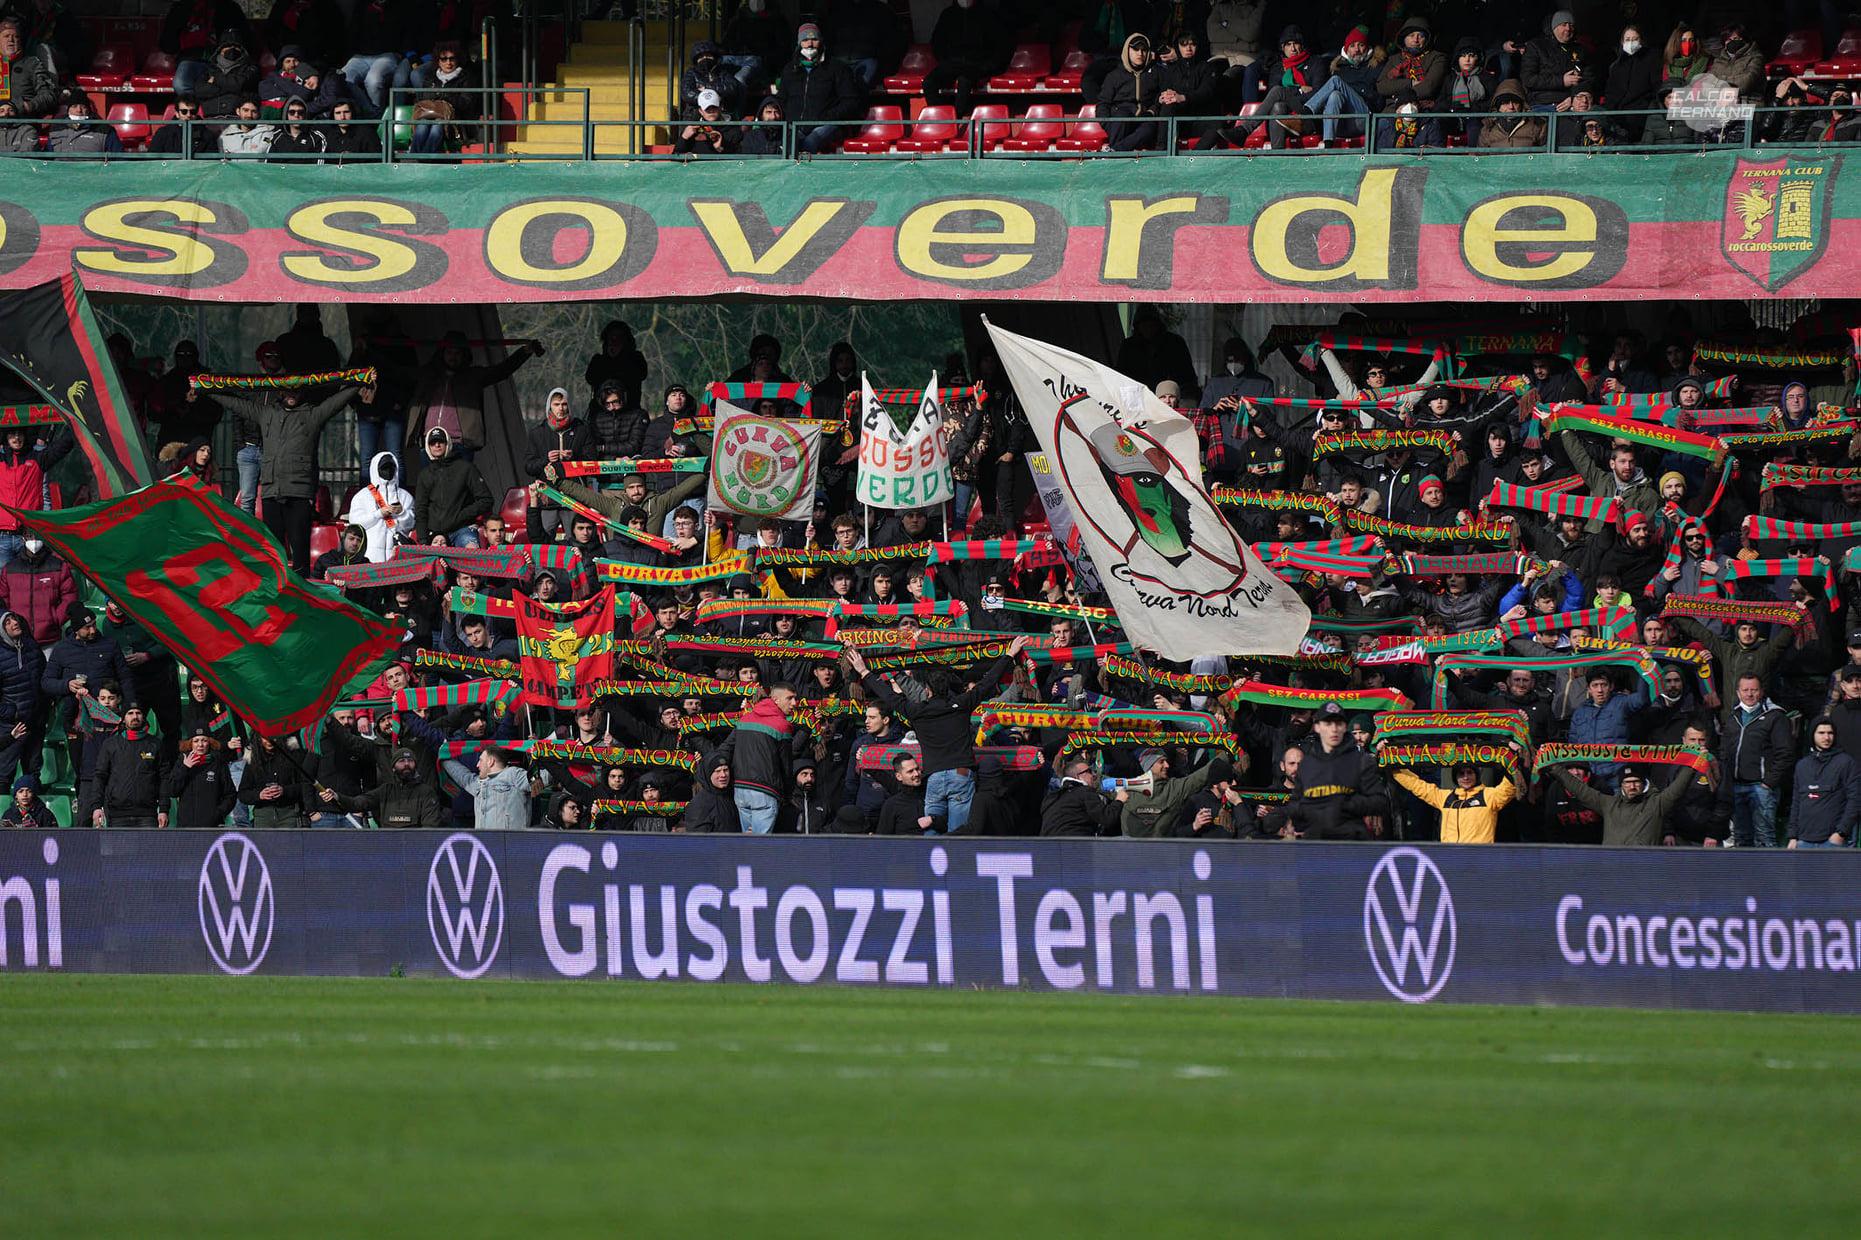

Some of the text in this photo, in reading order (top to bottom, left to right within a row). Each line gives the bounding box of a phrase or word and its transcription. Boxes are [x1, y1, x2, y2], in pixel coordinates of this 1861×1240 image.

[1742, 167, 1824, 178] TERNANA CLUB
[1728, 240, 1814, 252] roccarossoverde
[1620, 422, 1677, 445] CARASSI
[724, 426, 798, 472] CURVA
[724, 470, 790, 509] NORD
[1212, 485, 1264, 508] URVA
[1345, 508, 1508, 543] CURVA NORD
[758, 546, 836, 566] CURVA
[1178, 592, 1239, 618] Nord
[1298, 691, 1361, 701] CARASSI
[997, 711, 1090, 729] CURVA
[1383, 714, 1425, 733] Curva
[1432, 712, 1469, 727] Nord
[538, 841, 1220, 992] Giustozzi Terni
